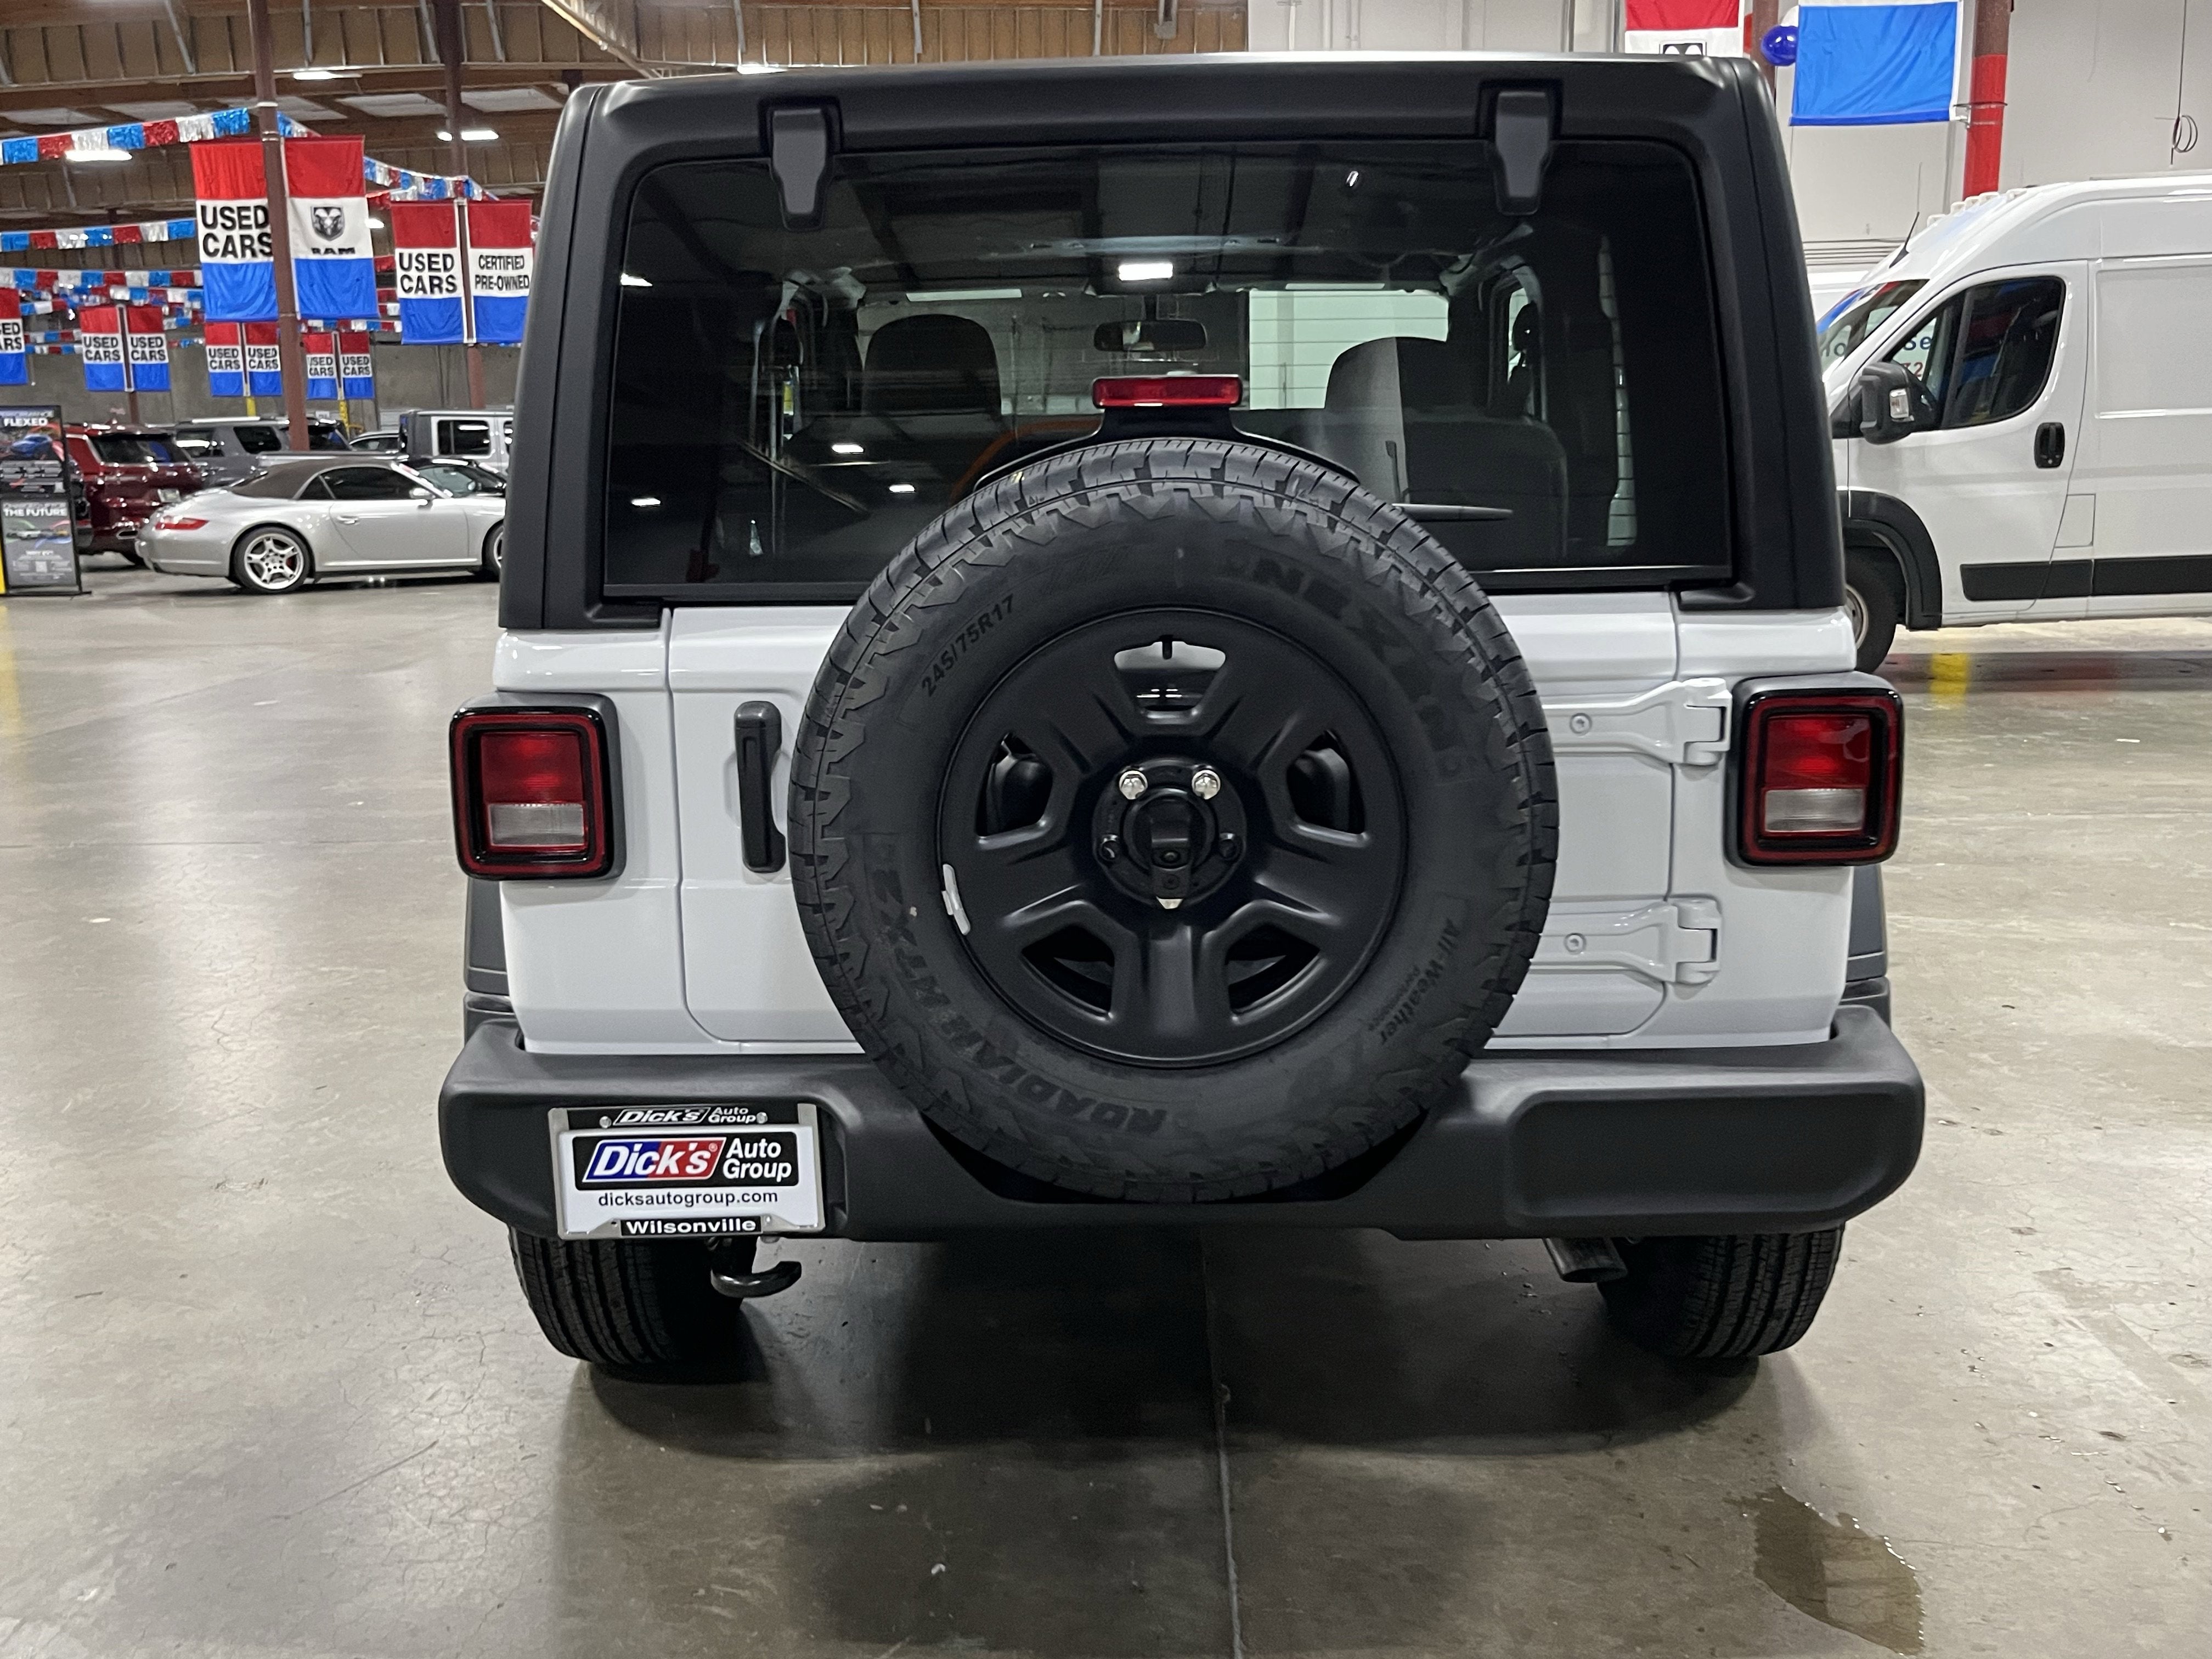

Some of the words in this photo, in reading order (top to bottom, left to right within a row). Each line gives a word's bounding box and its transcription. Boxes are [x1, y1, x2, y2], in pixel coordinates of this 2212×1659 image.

[201, 205, 269, 230] USED
[202, 232, 273, 258] CARS
[399, 252, 455, 272] USED
[478, 255, 524, 270] CERTIFIED
[400, 274, 457, 295] CARS
[475, 274, 529, 291] PRE-OWNED
[0, 323, 20, 335] ED
[0, 337, 22, 351] RS
[83, 336, 119, 348] USED
[131, 336, 163, 348] USED
[85, 350, 121, 362] CARS
[131, 349, 165, 361] CARS
[208, 348, 239, 358] USED
[248, 348, 277, 358] USED
[210, 359, 240, 370] CARS
[249, 359, 278, 370] CARS
[342, 356, 369, 365] USED
[309, 367, 334, 376] CARS
[343, 366, 370, 376] CARS
[4, 418, 48, 426] FLEXED
[921, 594, 1014, 697] 245/75R17
[1380, 917, 1462, 1046] All-Weather
[940, 1015, 1166, 1137] ROADIAN
[619, 1109, 701, 1123] Dick's
[708, 1114, 756, 1124] Group
[593, 1143, 712, 1176] Dick's
[726, 1138, 781, 1159] Auto
[723, 1158, 792, 1182] Group
[599, 1190, 778, 1207] dicksautogroup.com
[626, 1218, 757, 1234] Wilsonville
